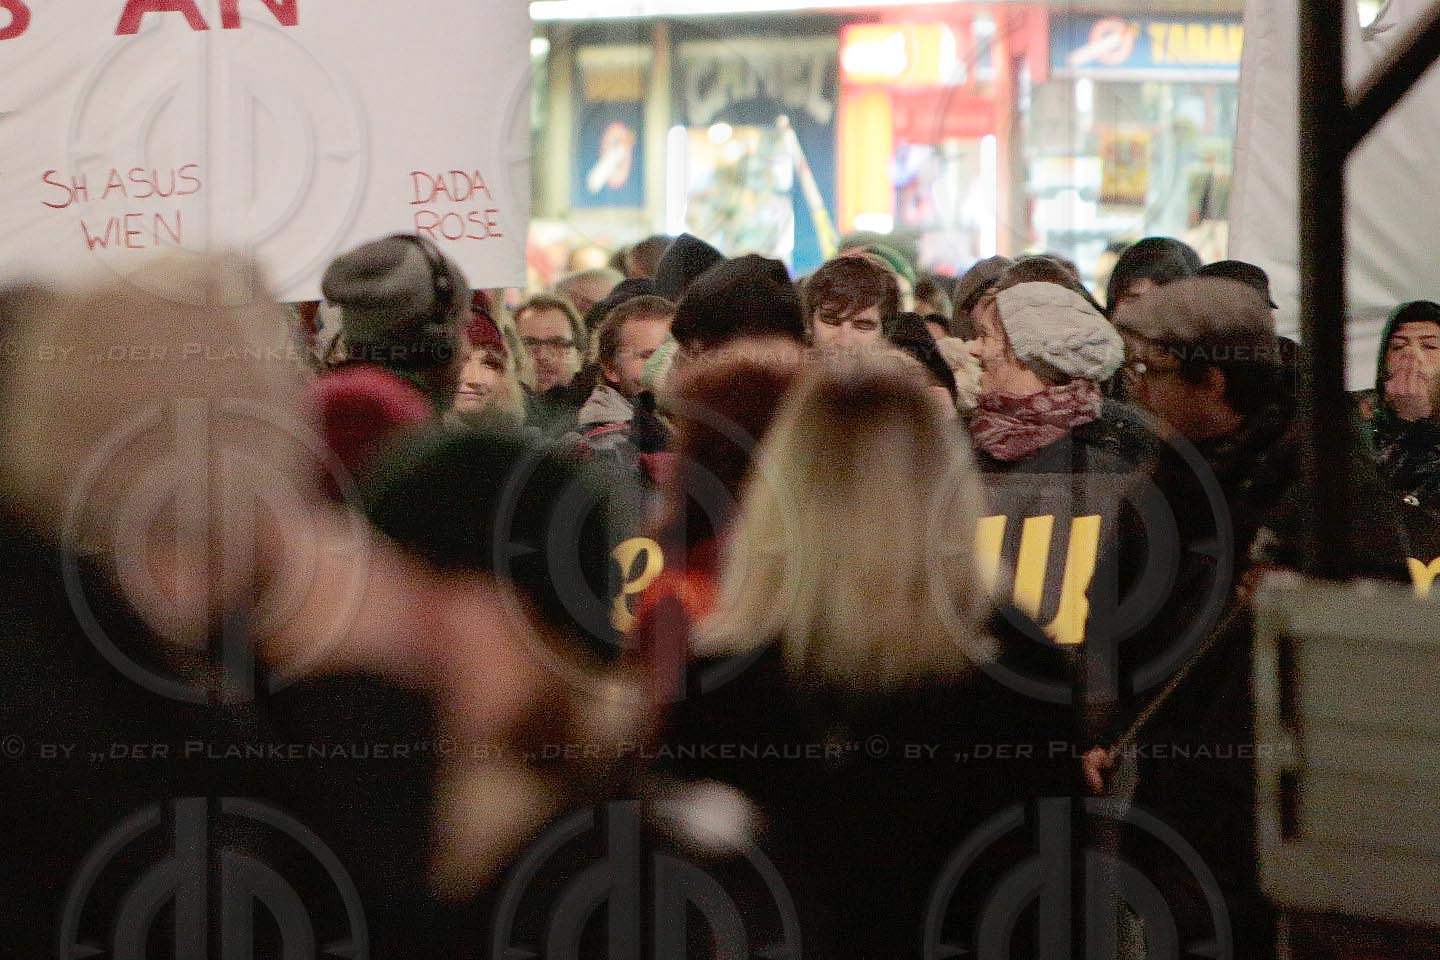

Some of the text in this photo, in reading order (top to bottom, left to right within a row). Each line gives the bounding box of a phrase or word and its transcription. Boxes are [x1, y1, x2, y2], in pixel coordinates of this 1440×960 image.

[407, 168, 493, 206] DADA
[79, 209, 183, 251] WIEN
[413, 208, 503, 240] ROSE
